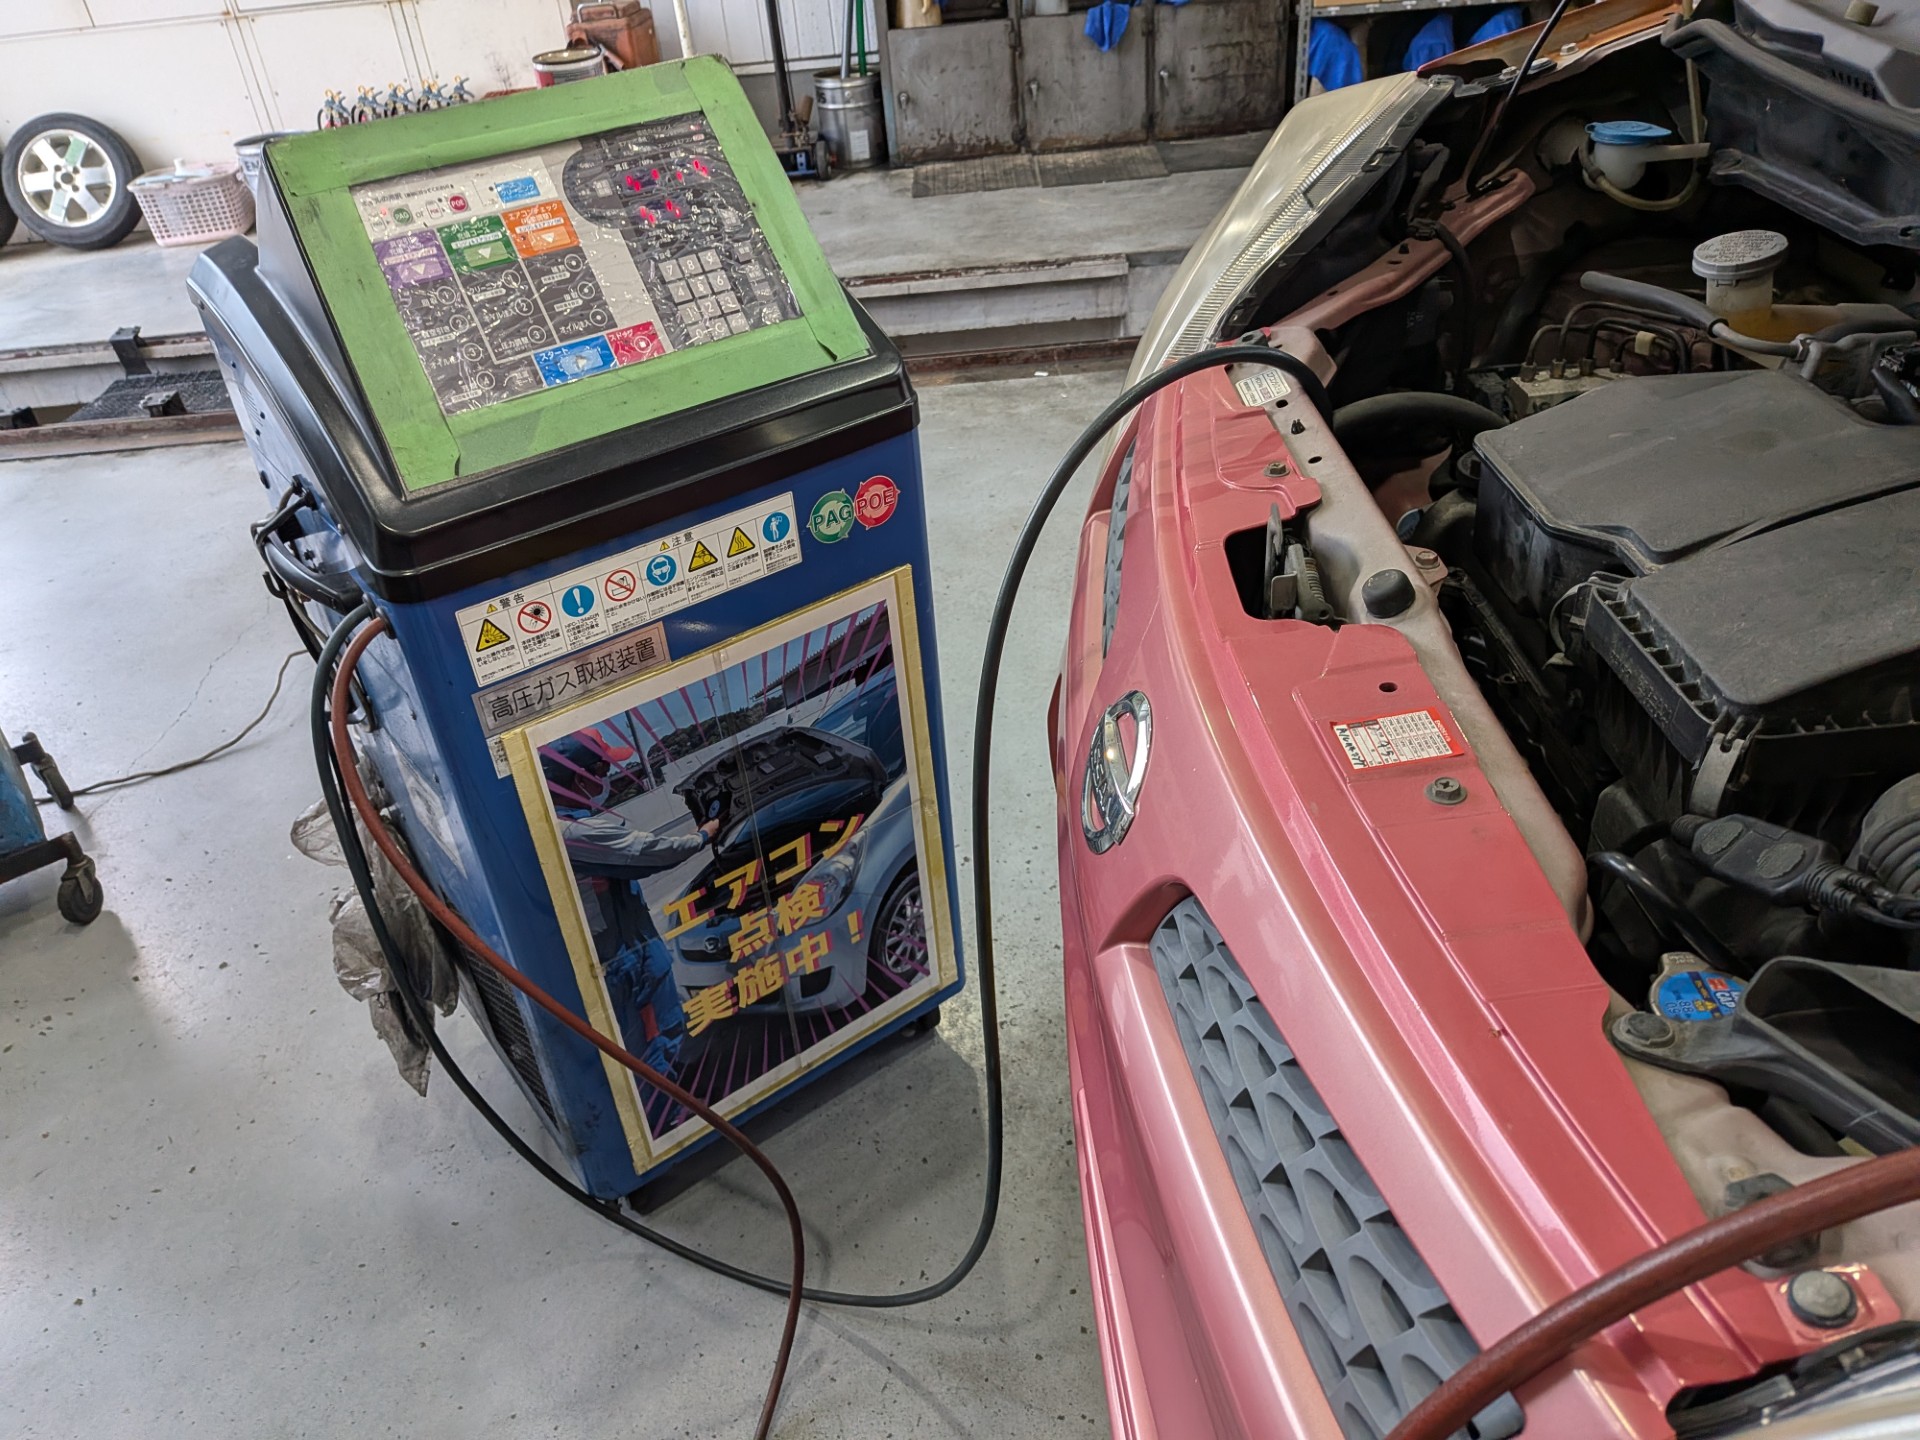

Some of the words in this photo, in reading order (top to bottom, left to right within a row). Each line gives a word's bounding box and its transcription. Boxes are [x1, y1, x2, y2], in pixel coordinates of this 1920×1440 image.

[450, 198, 464, 207] POE
[415, 210, 424, 218] or
[508, 203, 558, 220] エアコンチェック
[521, 302, 528, 311] 2
[533, 330, 540, 338] 3
[540, 346, 569, 361] スタート
[856, 486, 895, 516] POE
[812, 502, 853, 533] PAG
[670, 532, 694, 546] 注意
[498, 592, 525, 609] 警告
[488, 636, 658, 722] 高圧ガス取扱装置
[662, 813, 865, 941] エアコン
[729, 882, 826, 963] 点検
